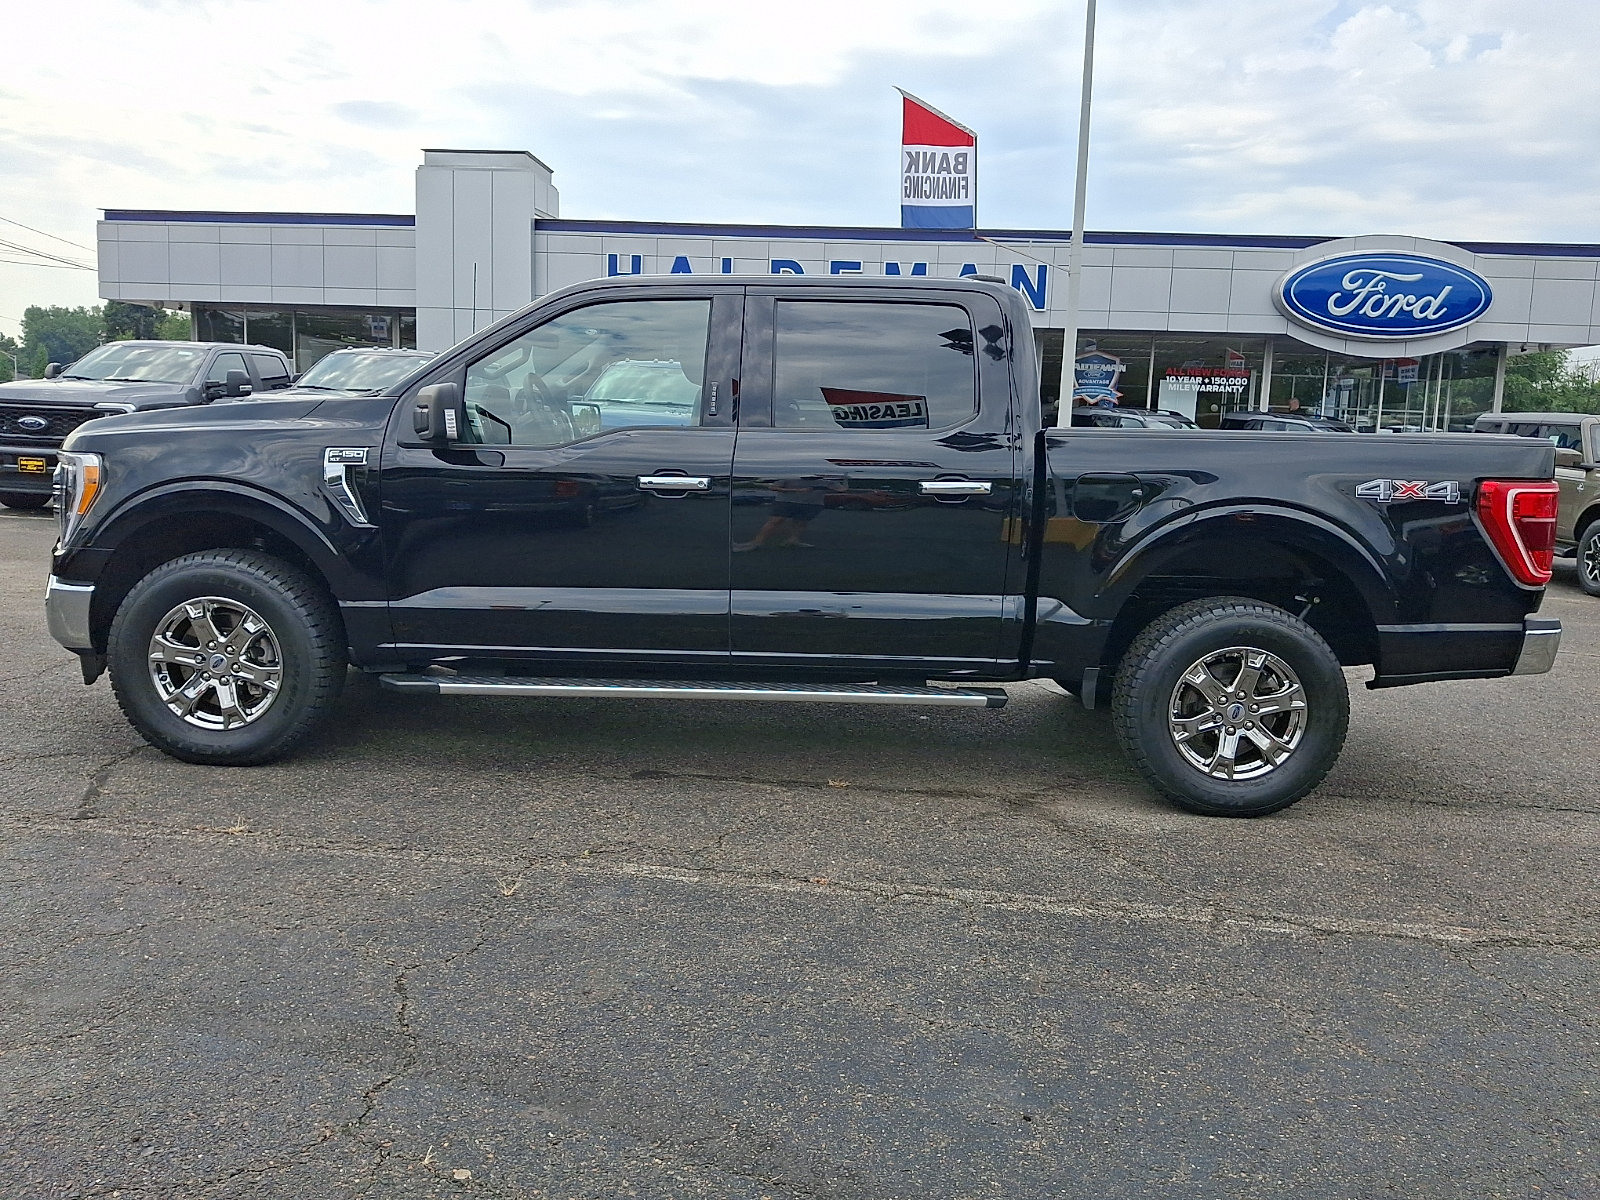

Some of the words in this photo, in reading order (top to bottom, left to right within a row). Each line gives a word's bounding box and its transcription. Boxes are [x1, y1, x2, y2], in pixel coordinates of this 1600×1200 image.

[1327, 268, 1453, 320] Ford
[1165, 367, 1185, 375] ALL
[1187, 368, 1211, 376] NEW
[1177, 376, 1202, 384] YEAR
[1211, 377, 1248, 386] 150,000
[1191, 384, 1245, 393] WARRANTY
[329, 450, 364, 458] F-150
